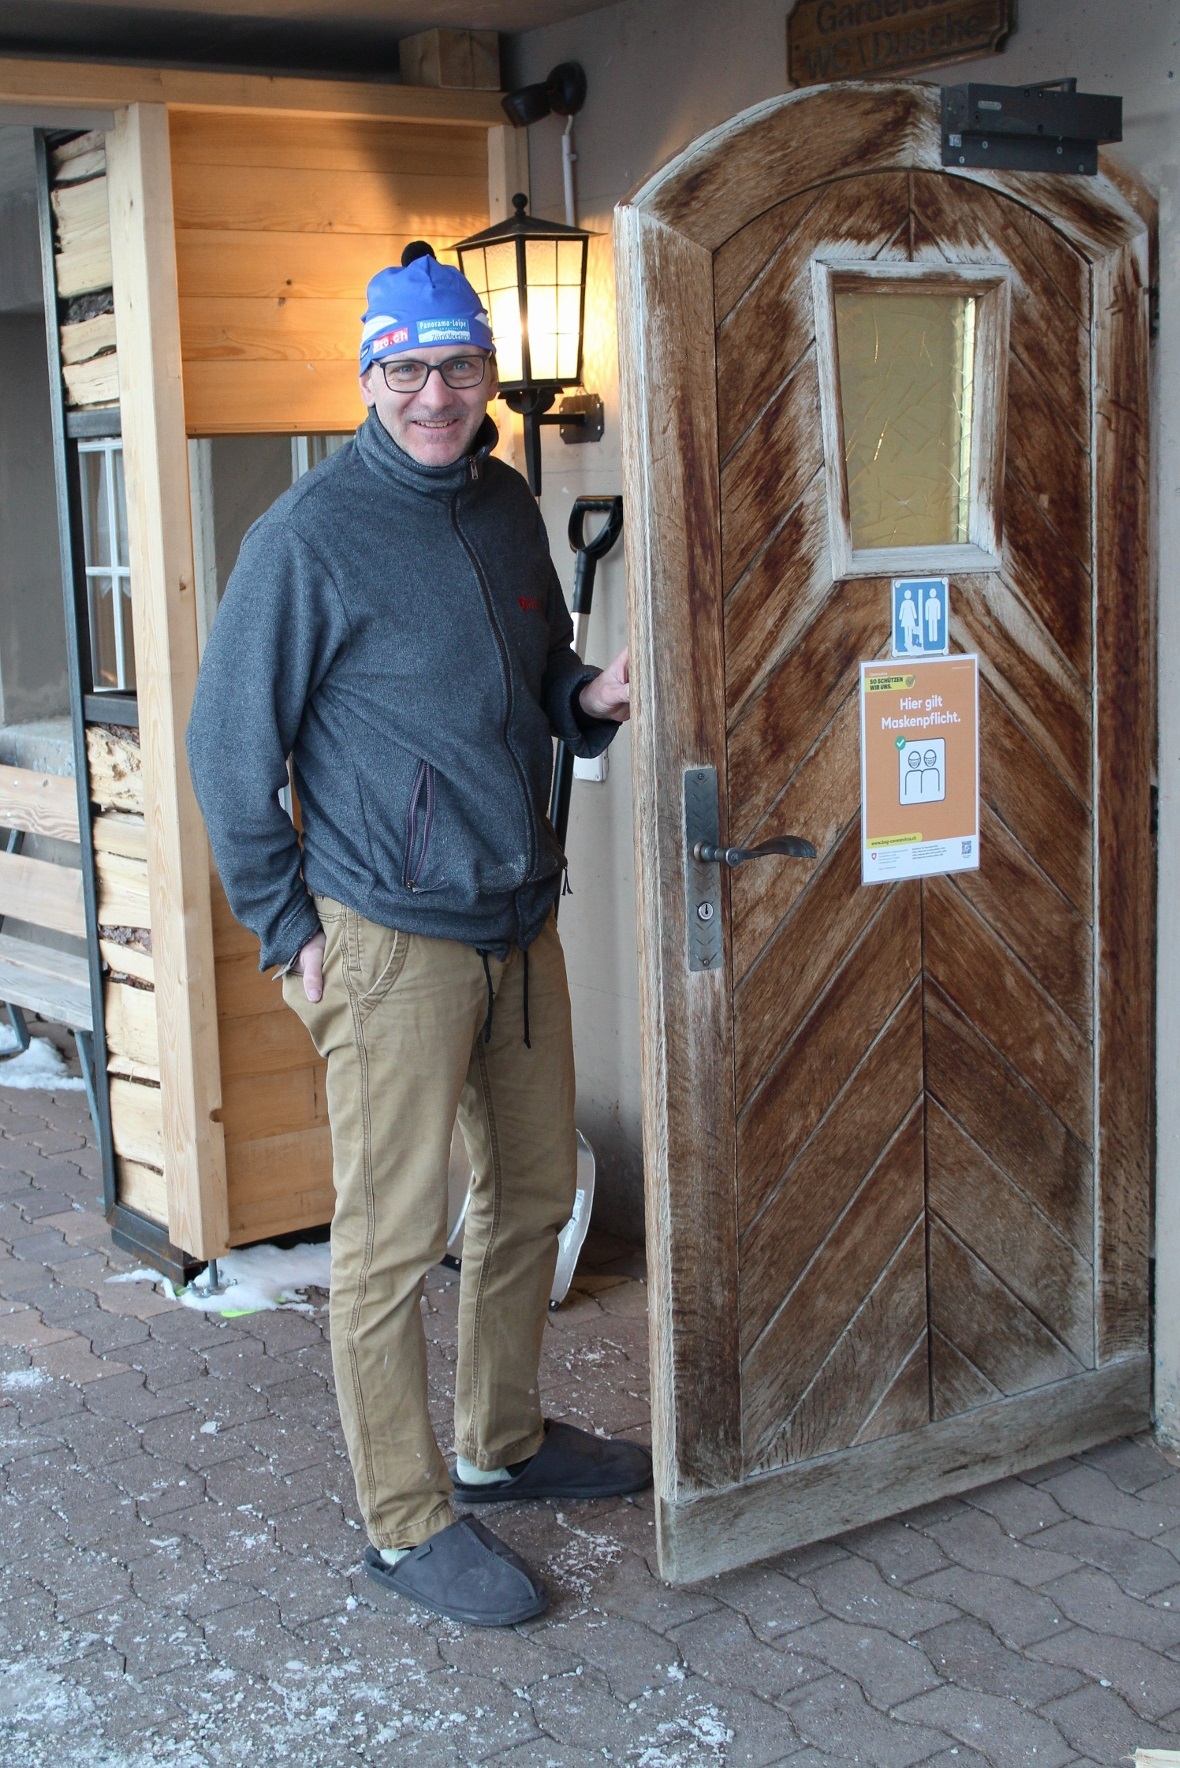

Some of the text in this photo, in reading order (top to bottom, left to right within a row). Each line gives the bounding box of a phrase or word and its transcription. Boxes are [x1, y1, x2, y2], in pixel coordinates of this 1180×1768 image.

[816, 0, 946, 35] Gardero
[878, 676, 904, 684] SCHÜTZEN
[900, 695, 943, 711] Hier gilt
[881, 711, 961, 730] Maskenpflicht.
